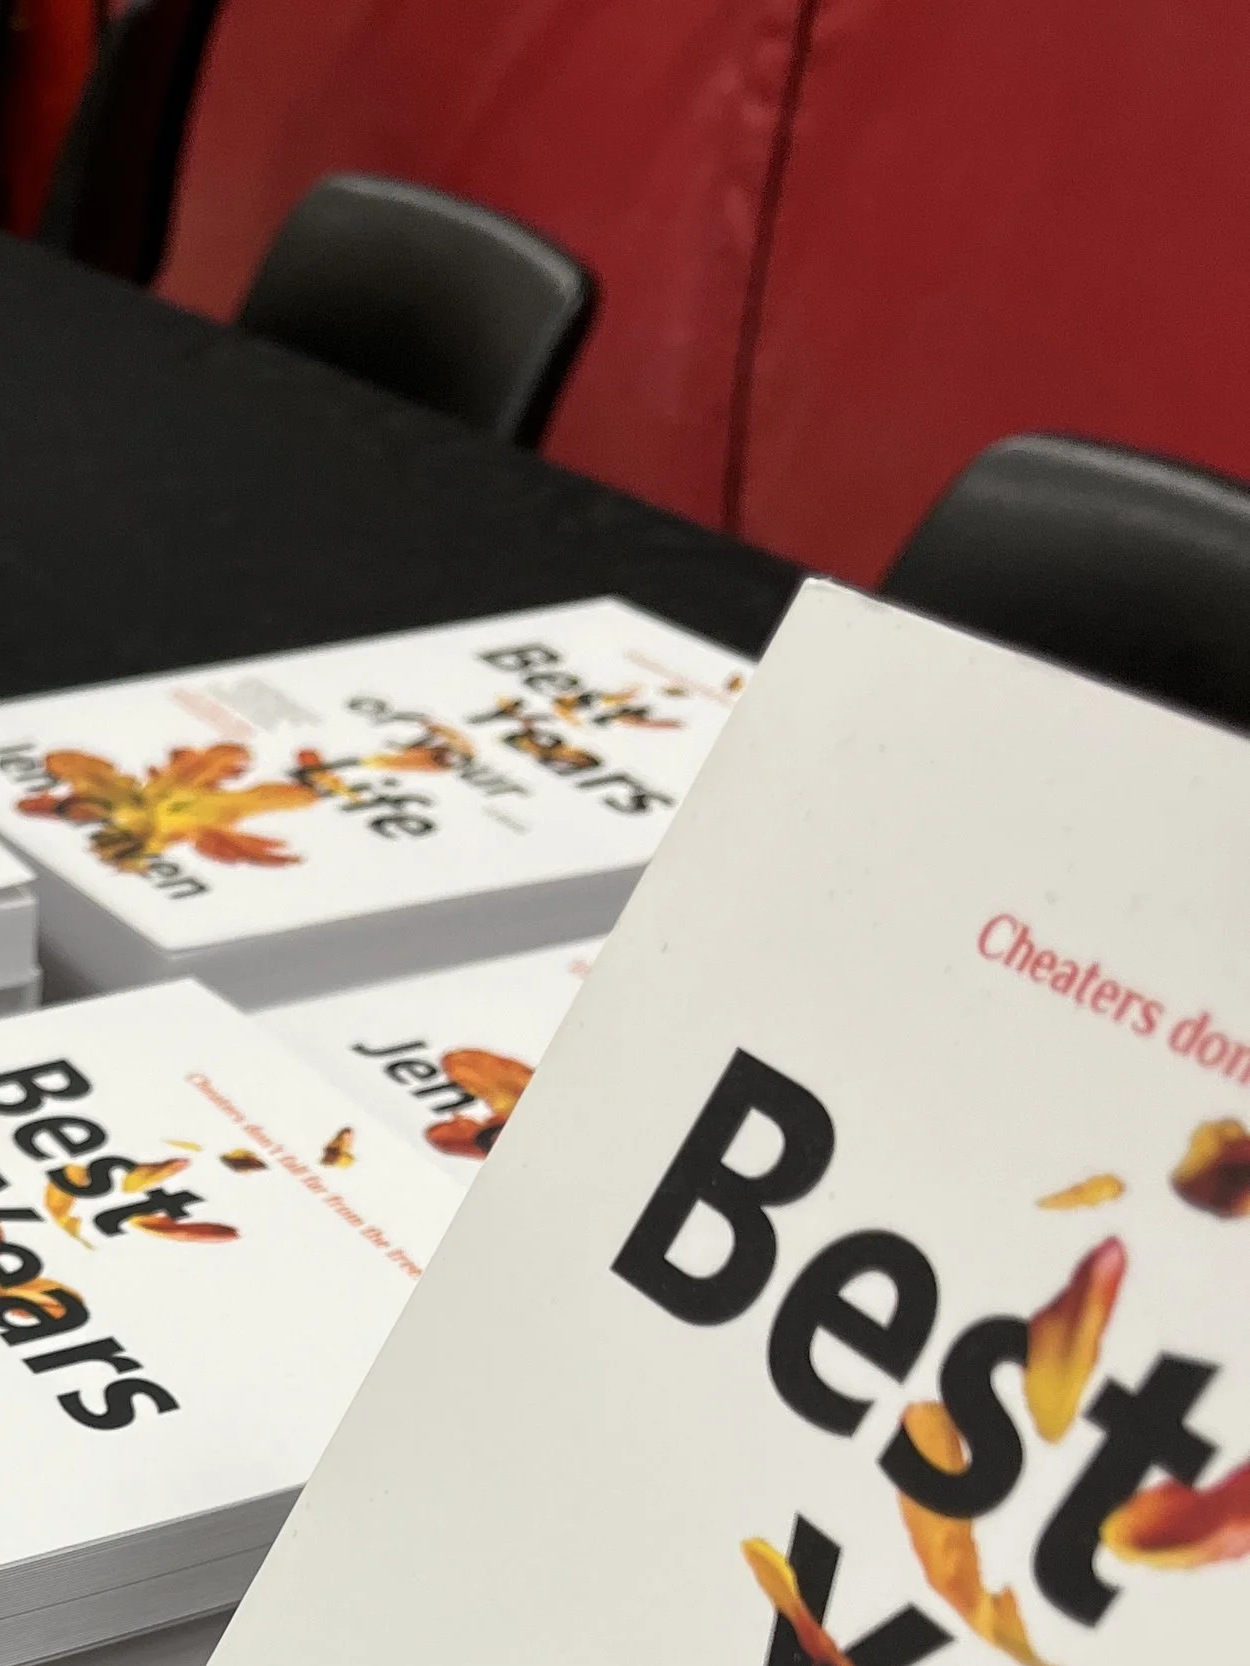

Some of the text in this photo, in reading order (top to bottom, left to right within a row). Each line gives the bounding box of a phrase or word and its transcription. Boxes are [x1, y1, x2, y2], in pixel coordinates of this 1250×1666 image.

[976, 912, 1166, 1038] Cheaters
[350, 1039, 478, 1116] Jen
[609, 1046, 1223, 1629] Best
